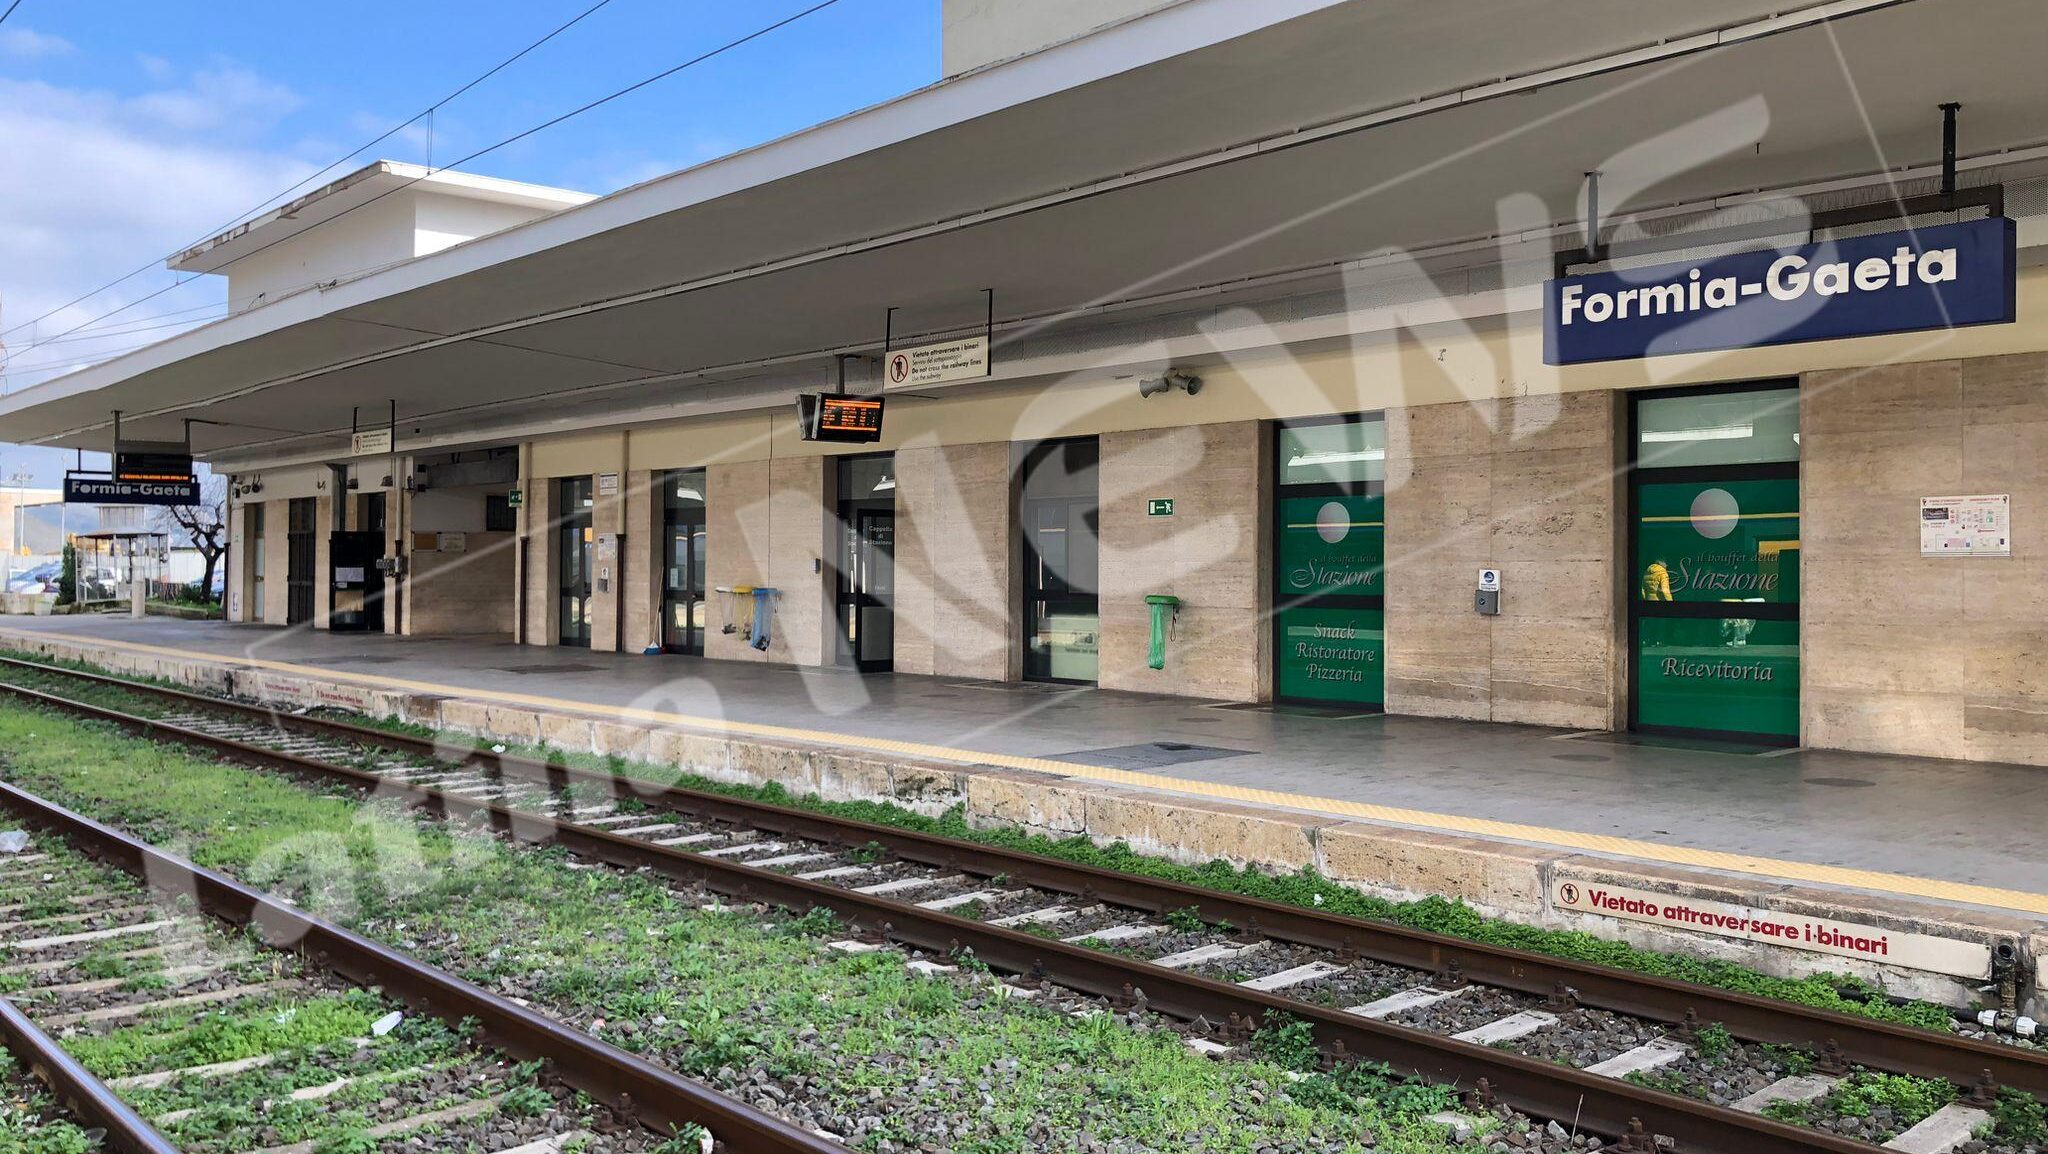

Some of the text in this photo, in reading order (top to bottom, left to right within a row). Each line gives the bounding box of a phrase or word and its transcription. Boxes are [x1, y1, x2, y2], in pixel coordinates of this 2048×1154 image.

[1561, 247, 1958, 326] Formia-Gaeta
[71, 480, 191, 496] Formia-Gaeta
[1289, 557, 1377, 588] Stazione
[1668, 556, 1779, 593] Stazione
[1313, 620, 1357, 640] Snack
[1295, 641, 1376, 661] Ristoratore
[1305, 663, 1363, 683] Pizzeria
[1660, 656, 1774, 682] Ricevitoria
[1588, 888, 1889, 955] Vietato attraversare i binari
